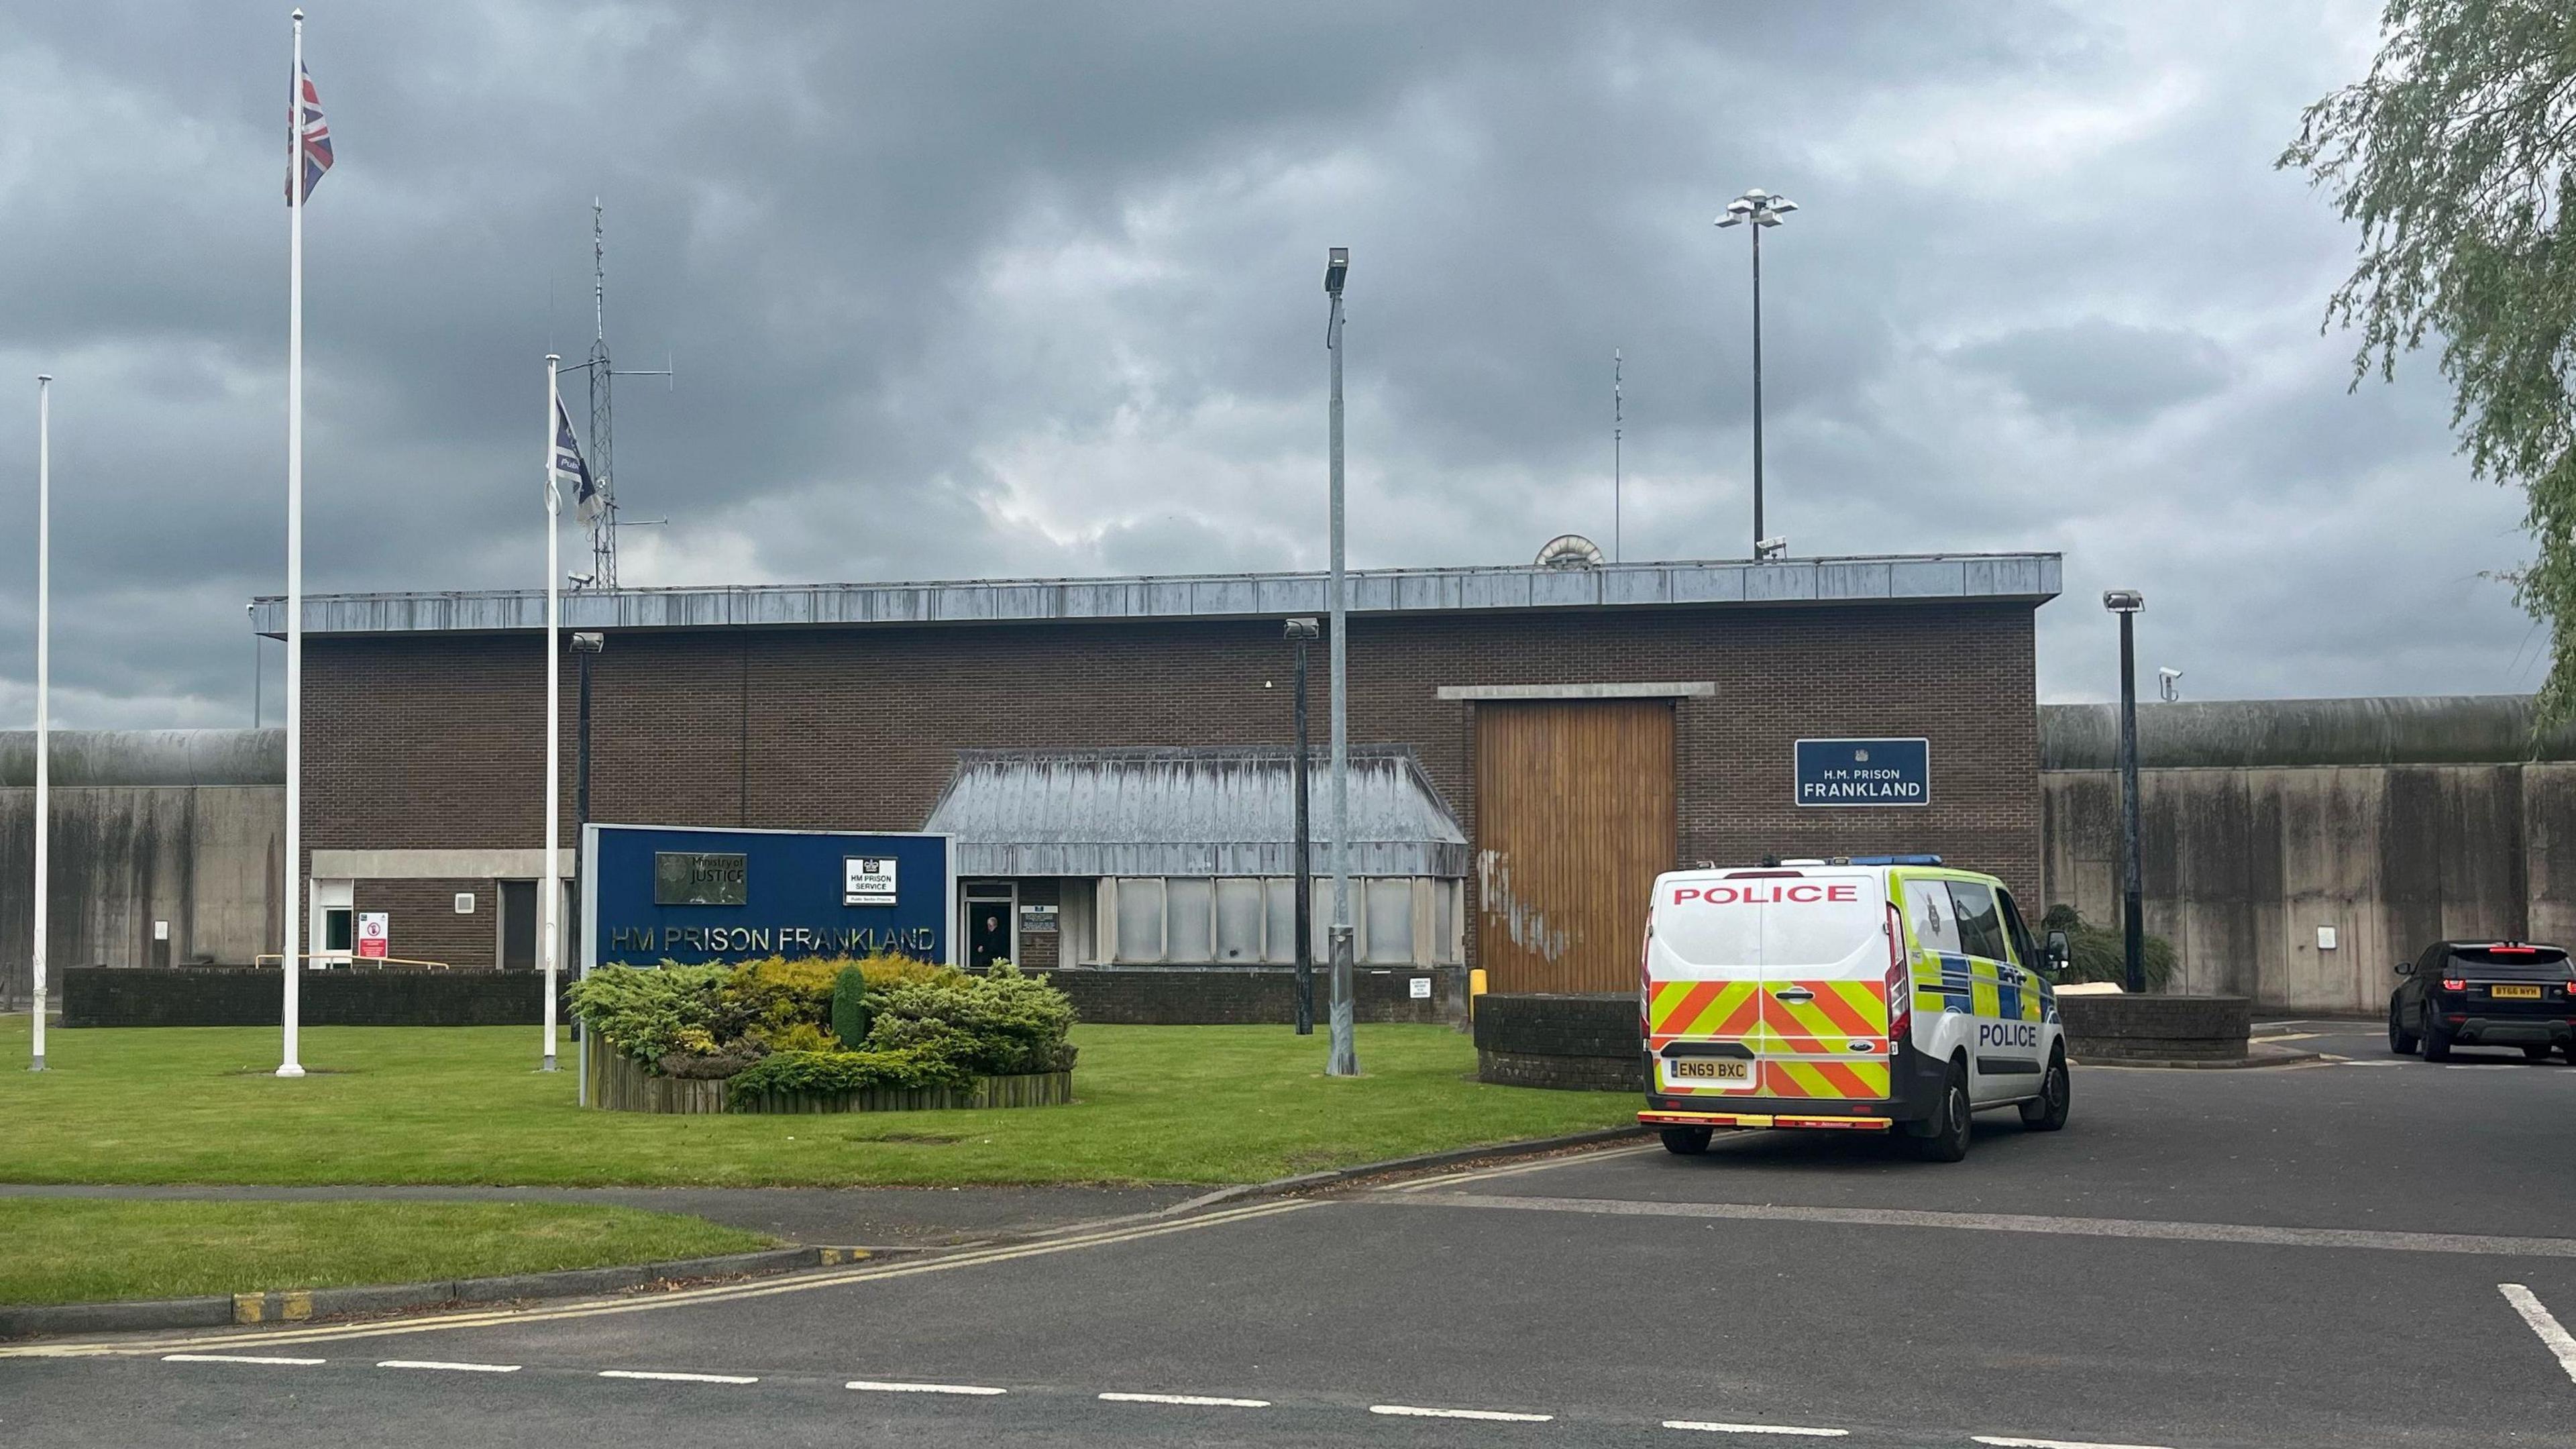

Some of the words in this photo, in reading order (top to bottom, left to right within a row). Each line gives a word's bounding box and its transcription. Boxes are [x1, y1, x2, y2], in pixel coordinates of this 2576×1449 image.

[1824, 770, 1850, 780] H.M.
[1854, 769, 1900, 780] PRISON
[1804, 782, 1920, 797] FRANKLAND
[692, 857, 731, 869] Ministry
[734, 857, 743, 867] of
[690, 869, 744, 884] JUSTICE
[1674, 885, 1858, 905] POLICE
[612, 927, 654, 951] HM
[664, 927, 769, 951] PRISON
[779, 927, 935, 951] FRANKLAND
[1980, 1024, 2037, 1047] POLICE
[1679, 1063, 1714, 1076] EN69
[1718, 1064, 1744, 1077] BXC
